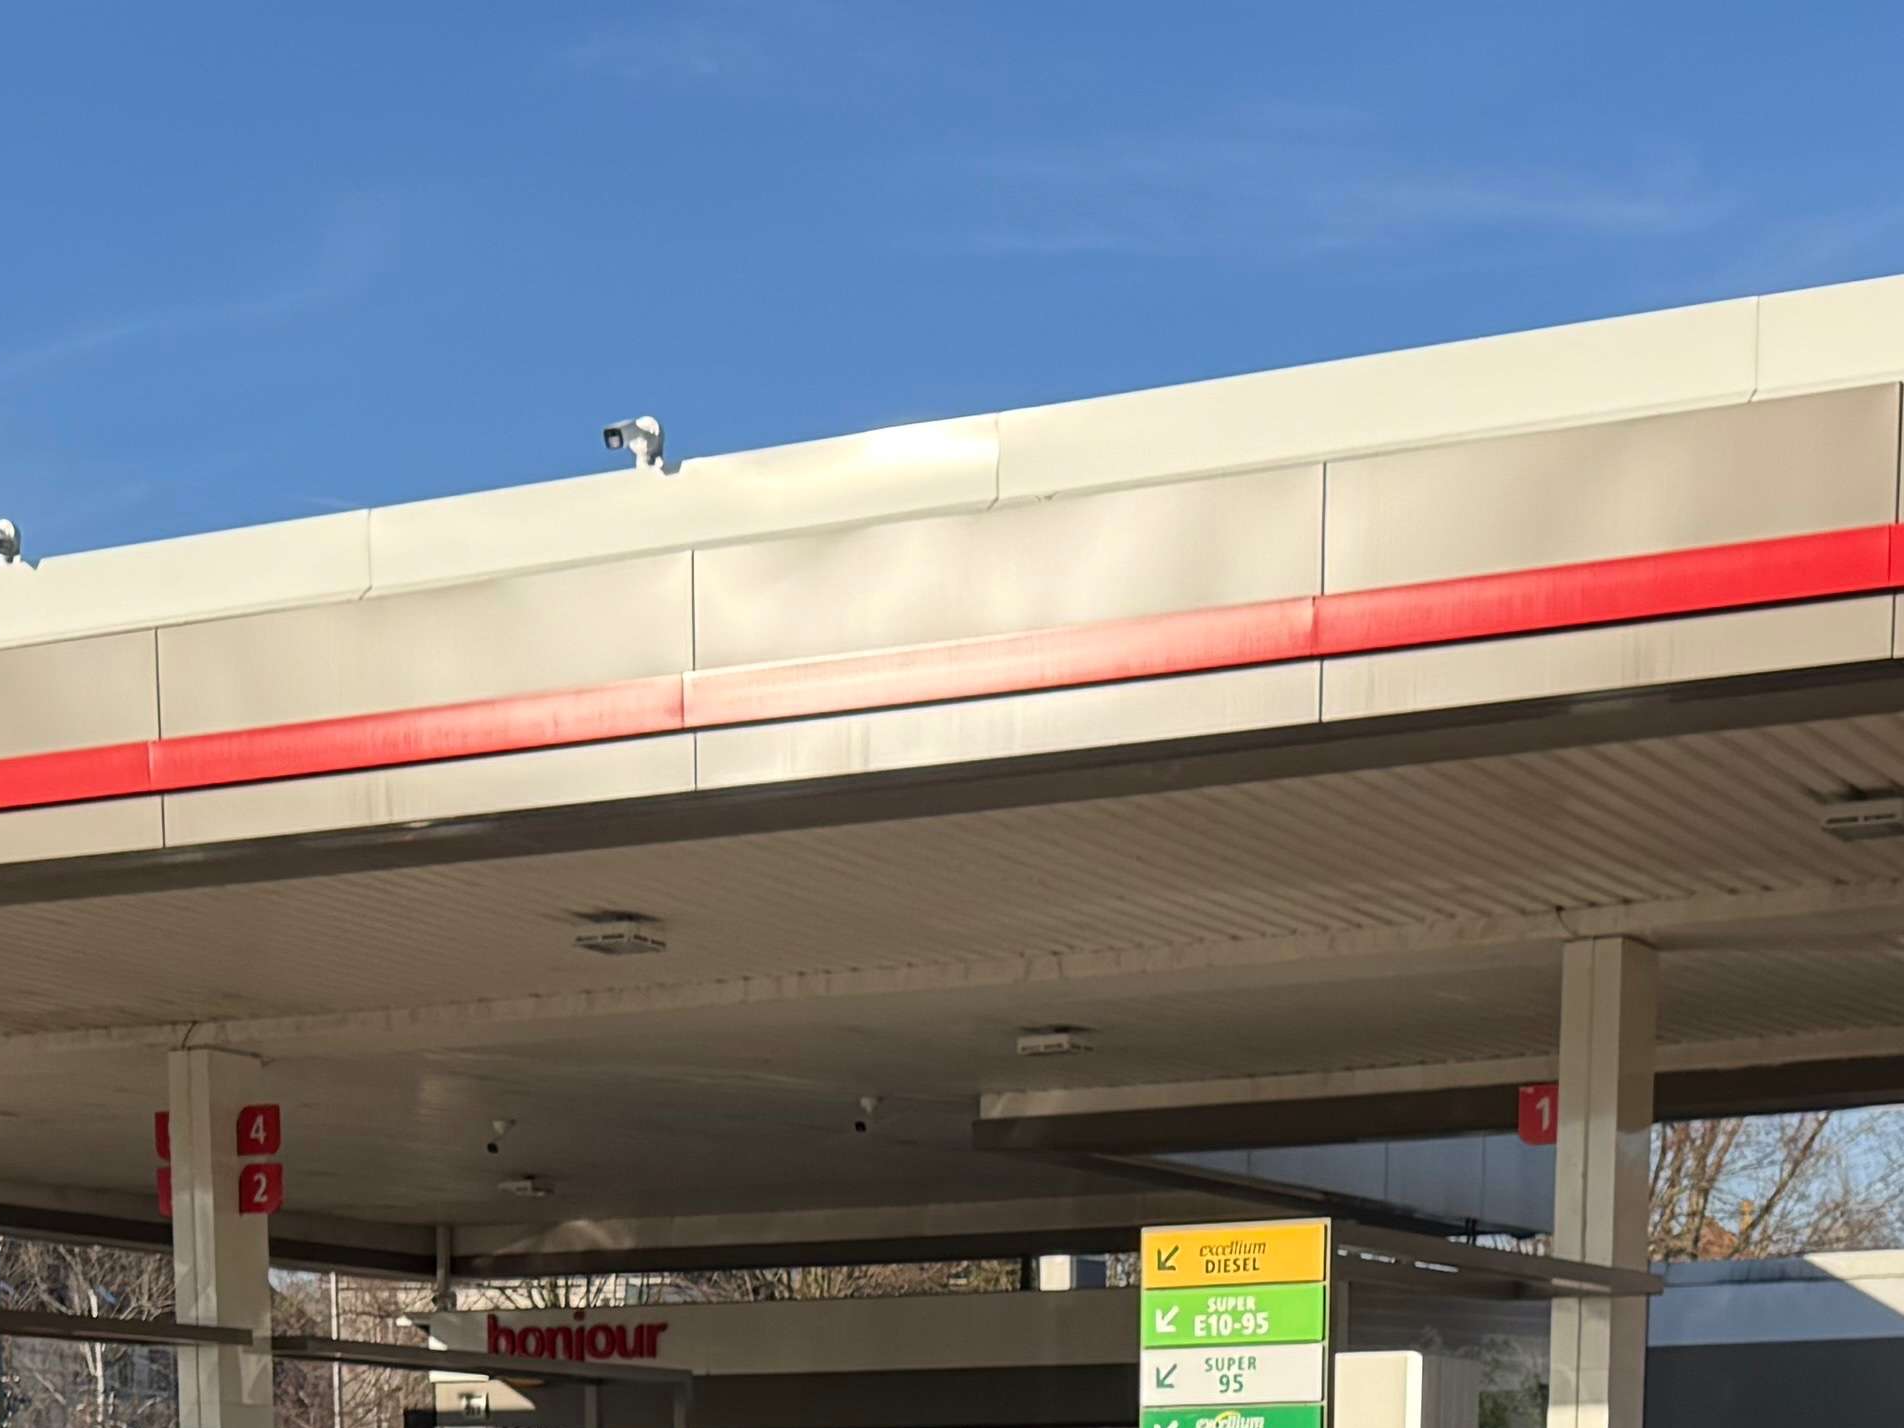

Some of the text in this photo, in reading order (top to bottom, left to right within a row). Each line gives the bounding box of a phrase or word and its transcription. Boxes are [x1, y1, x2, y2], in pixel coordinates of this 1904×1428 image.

[1536, 1096, 1550, 1132] 1
[250, 1115, 266, 1144] 4
[253, 1173, 268, 1203] 2
[1199, 1240, 1266, 1257] excellium
[1205, 1258, 1260, 1274] DIESEL
[1207, 1296, 1257, 1313] SUPER
[1194, 1312, 1270, 1337] E10-95
[487, 1312, 667, 1361] bonjour
[1204, 1356, 1257, 1372] SUPER
[1219, 1374, 1244, 1393] 95
